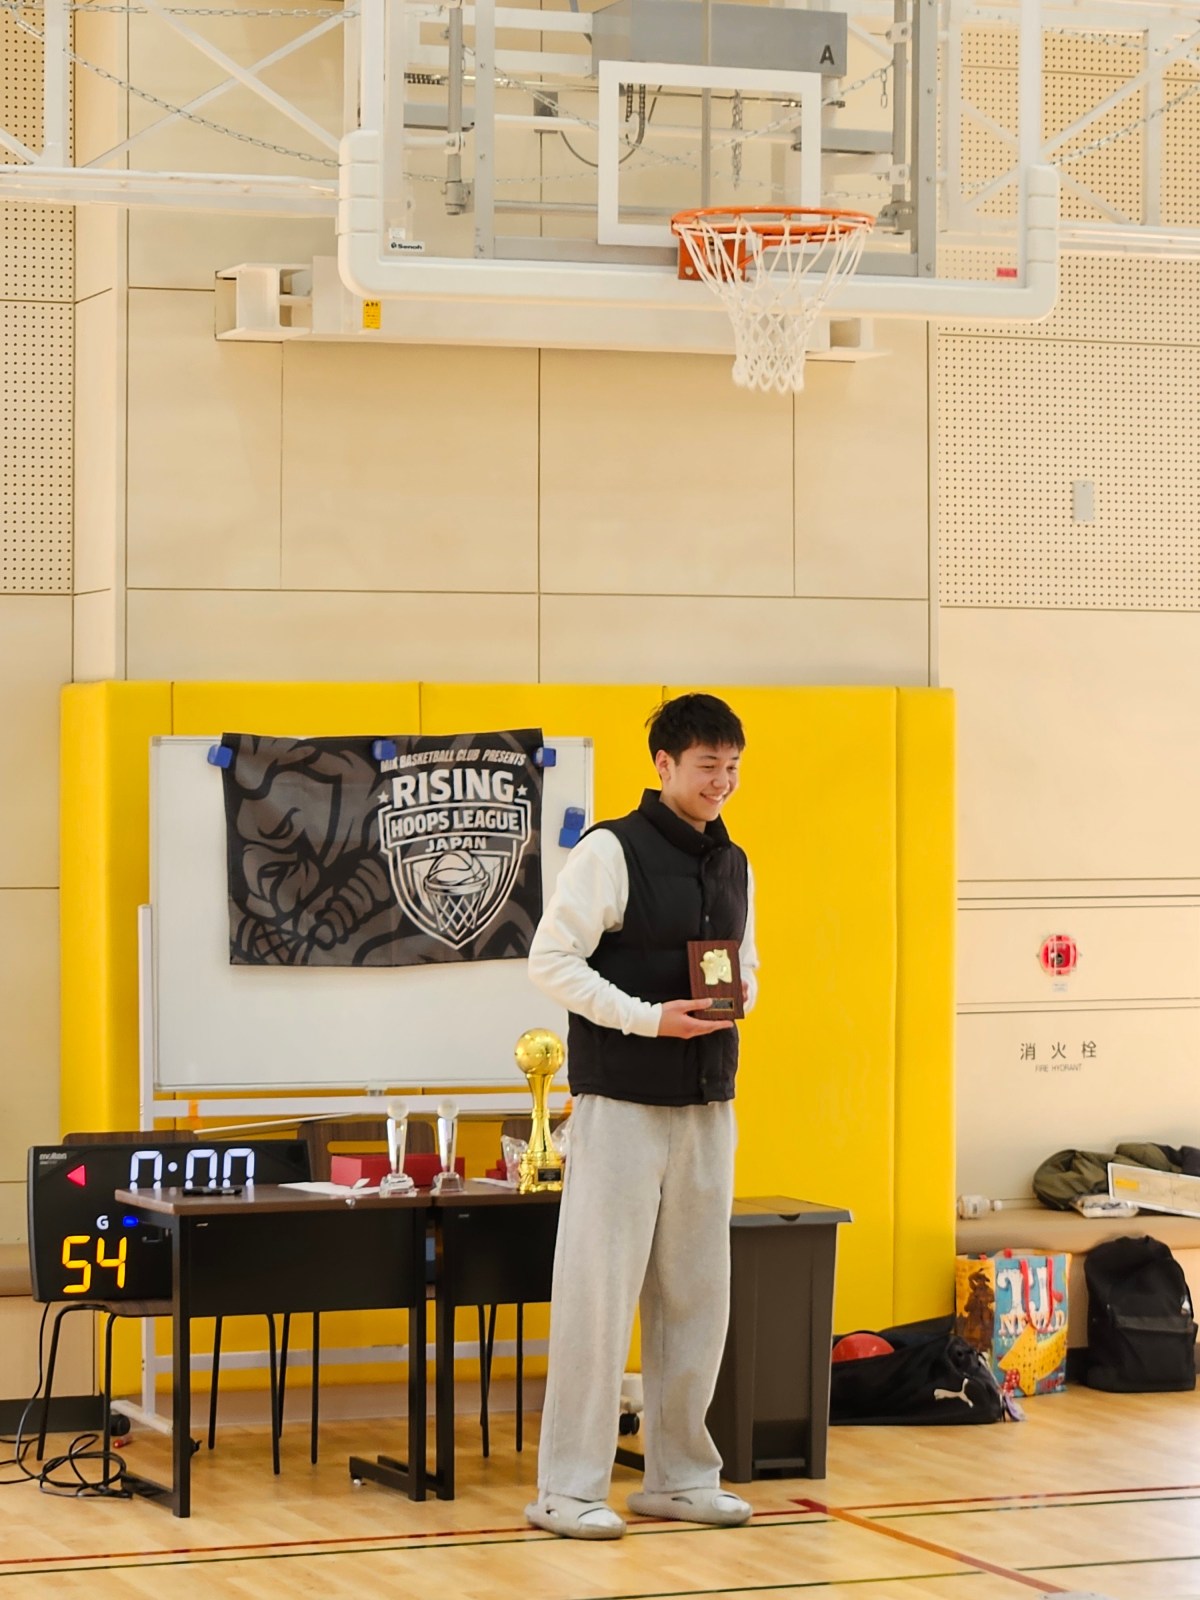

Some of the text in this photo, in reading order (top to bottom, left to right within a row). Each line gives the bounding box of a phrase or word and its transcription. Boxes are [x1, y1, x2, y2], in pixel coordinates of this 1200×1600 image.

[819, 44, 835, 65] A
[399, 750, 455, 769] BASKETBALL
[456, 749, 480, 761] CLUB
[482, 749, 527, 766] PRESENTS
[392, 768, 515, 808] RISING
[391, 809, 521, 838] HOOPS LEAGUE
[425, 836, 488, 852] JAPAN
[1020, 1040, 1097, 1061] 消火栓
[96, 1215, 109, 1230] G
[62, 1235, 127, 1293] 54
